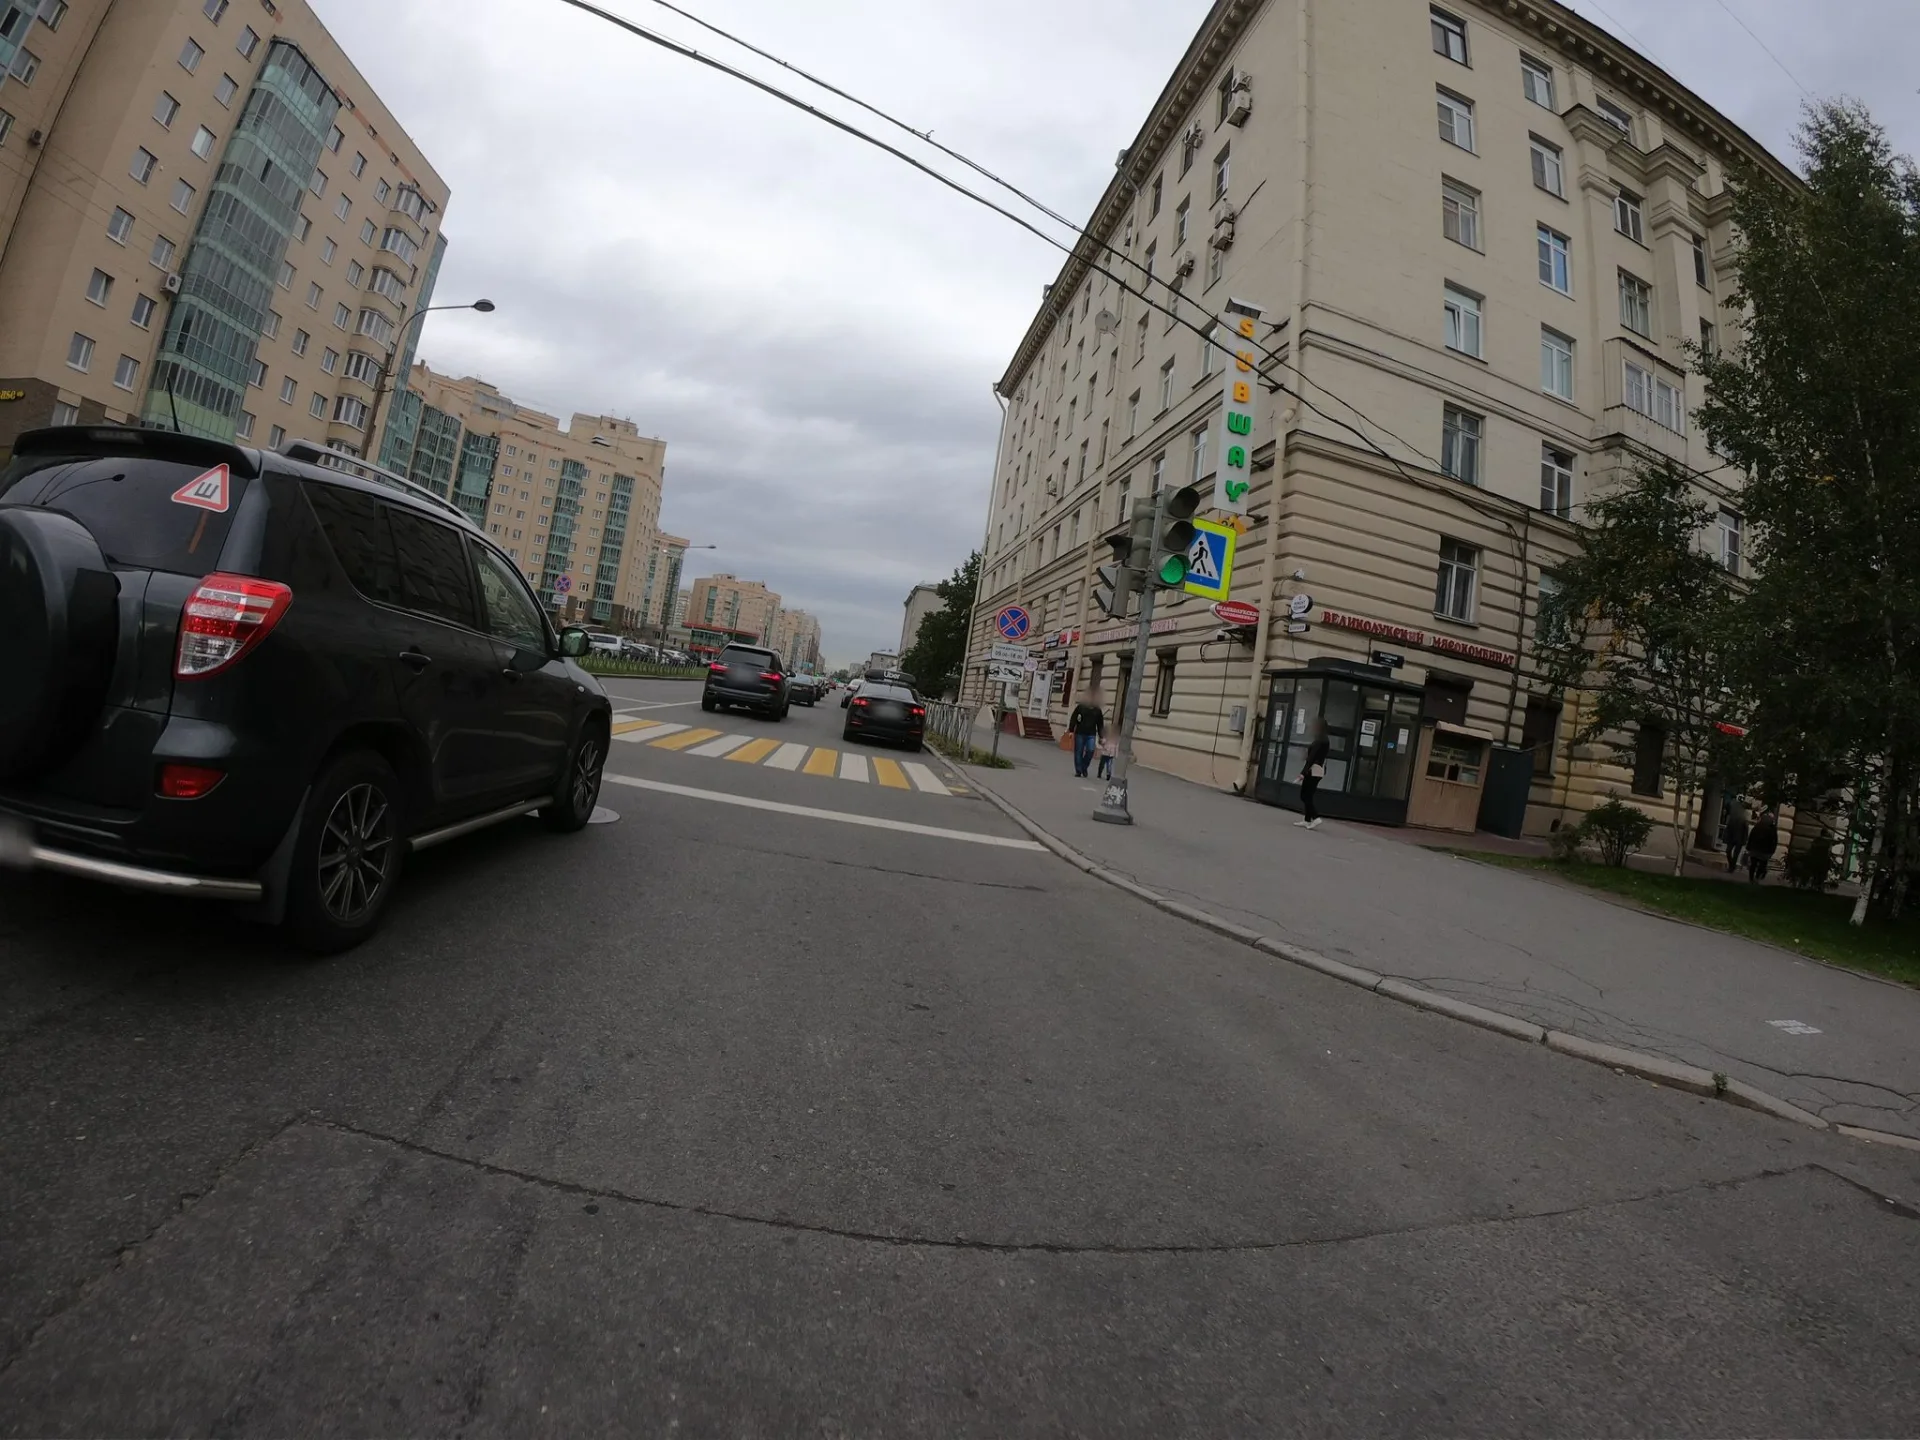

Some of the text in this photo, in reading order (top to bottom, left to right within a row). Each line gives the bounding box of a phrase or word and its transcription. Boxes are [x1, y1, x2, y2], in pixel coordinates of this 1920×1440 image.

[1225, 317, 1255, 503] SUBWAY
[194, 481, 219, 499] Ш
[1322, 609, 1515, 665] ВЕЛИКОЛУКСКИЙ МЯСОКОМБИНАТ
[883, 670, 900, 680] Uber
